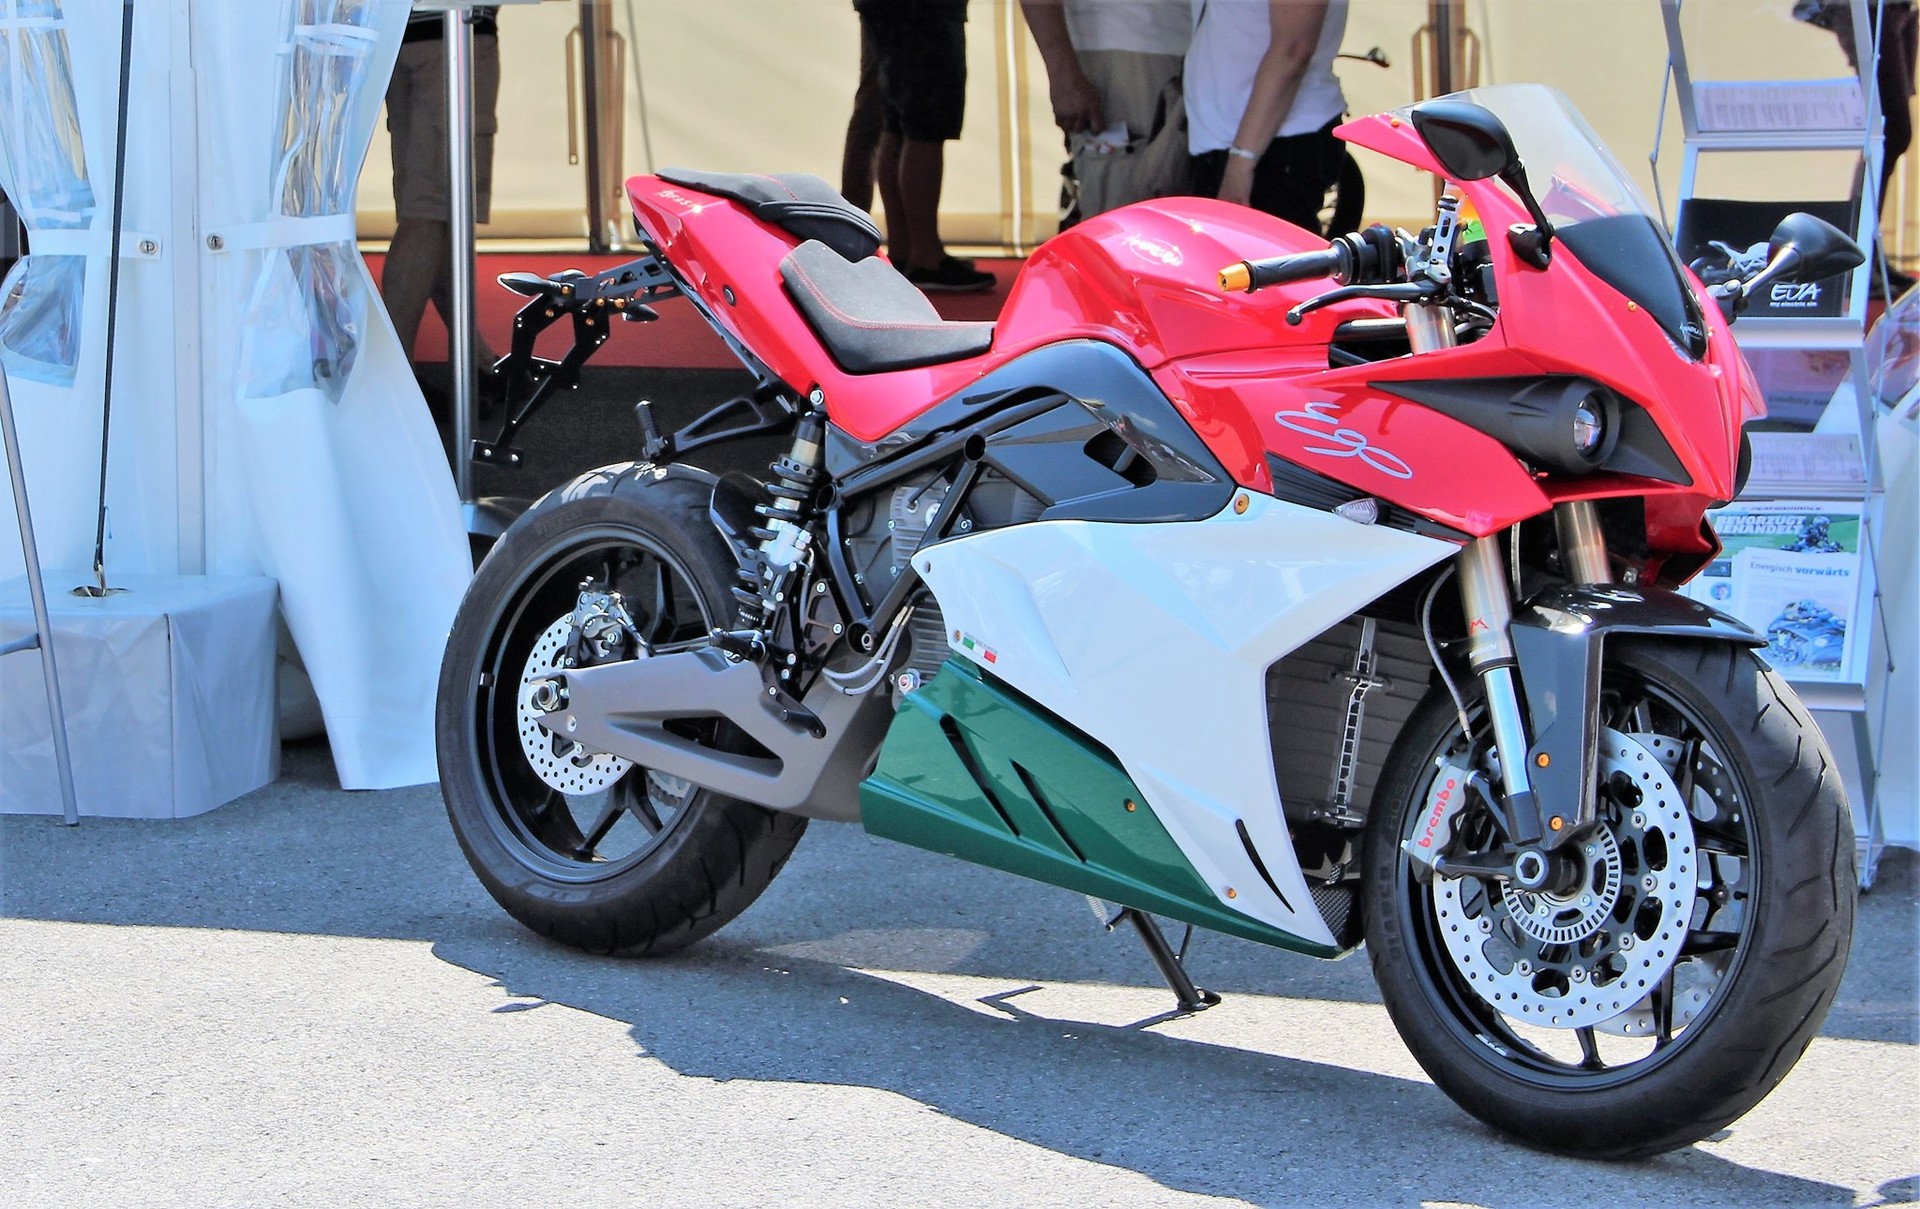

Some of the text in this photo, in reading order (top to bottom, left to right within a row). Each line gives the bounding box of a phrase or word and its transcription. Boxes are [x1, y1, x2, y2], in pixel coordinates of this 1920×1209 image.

[1715, 514, 1807, 526] BEVORZUGT
[1713, 524, 1804, 535] BEHANDELT
[1750, 560, 1850, 577] Energisch vorwärts
[1417, 778, 1457, 849] brembo
